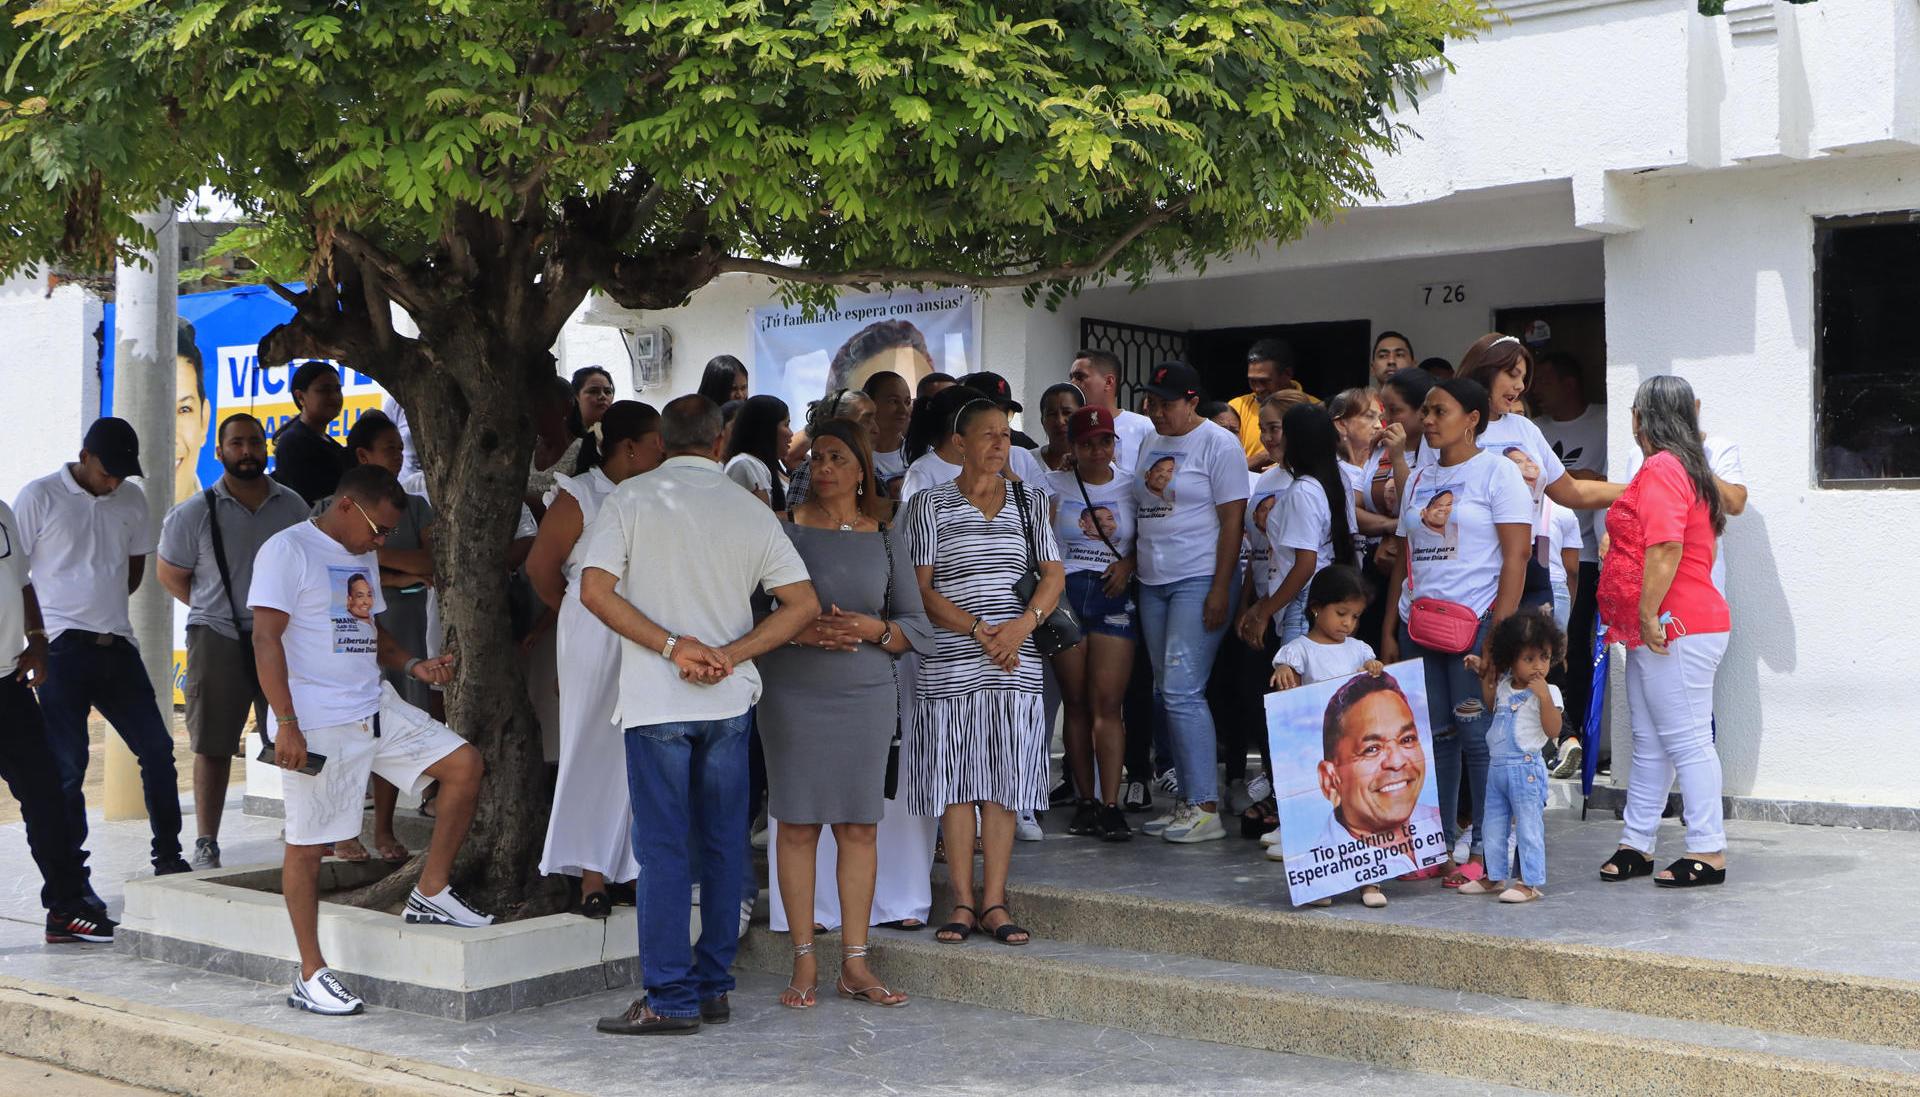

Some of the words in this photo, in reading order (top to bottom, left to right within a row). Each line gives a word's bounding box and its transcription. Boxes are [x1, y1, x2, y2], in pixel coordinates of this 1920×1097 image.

[1423, 287, 1432, 305] 7
[1443, 284, 1465, 303] 26
[761, 313, 780, 332] ¡Tú
[829, 309, 842, 322] te
[845, 304, 887, 321] espera
[890, 303, 913, 315] con
[916, 295, 964, 313] ansias!
[1437, 546, 1455, 554] para
[1310, 846, 1335, 863] Tio
[1337, 830, 1395, 862] padrino
[1401, 823, 1417, 837] te
[1288, 850, 1371, 887] Esperamos
[1374, 837, 1424, 866] pronto
[1426, 831, 1445, 846] en
[1355, 863, 1388, 883] casa
